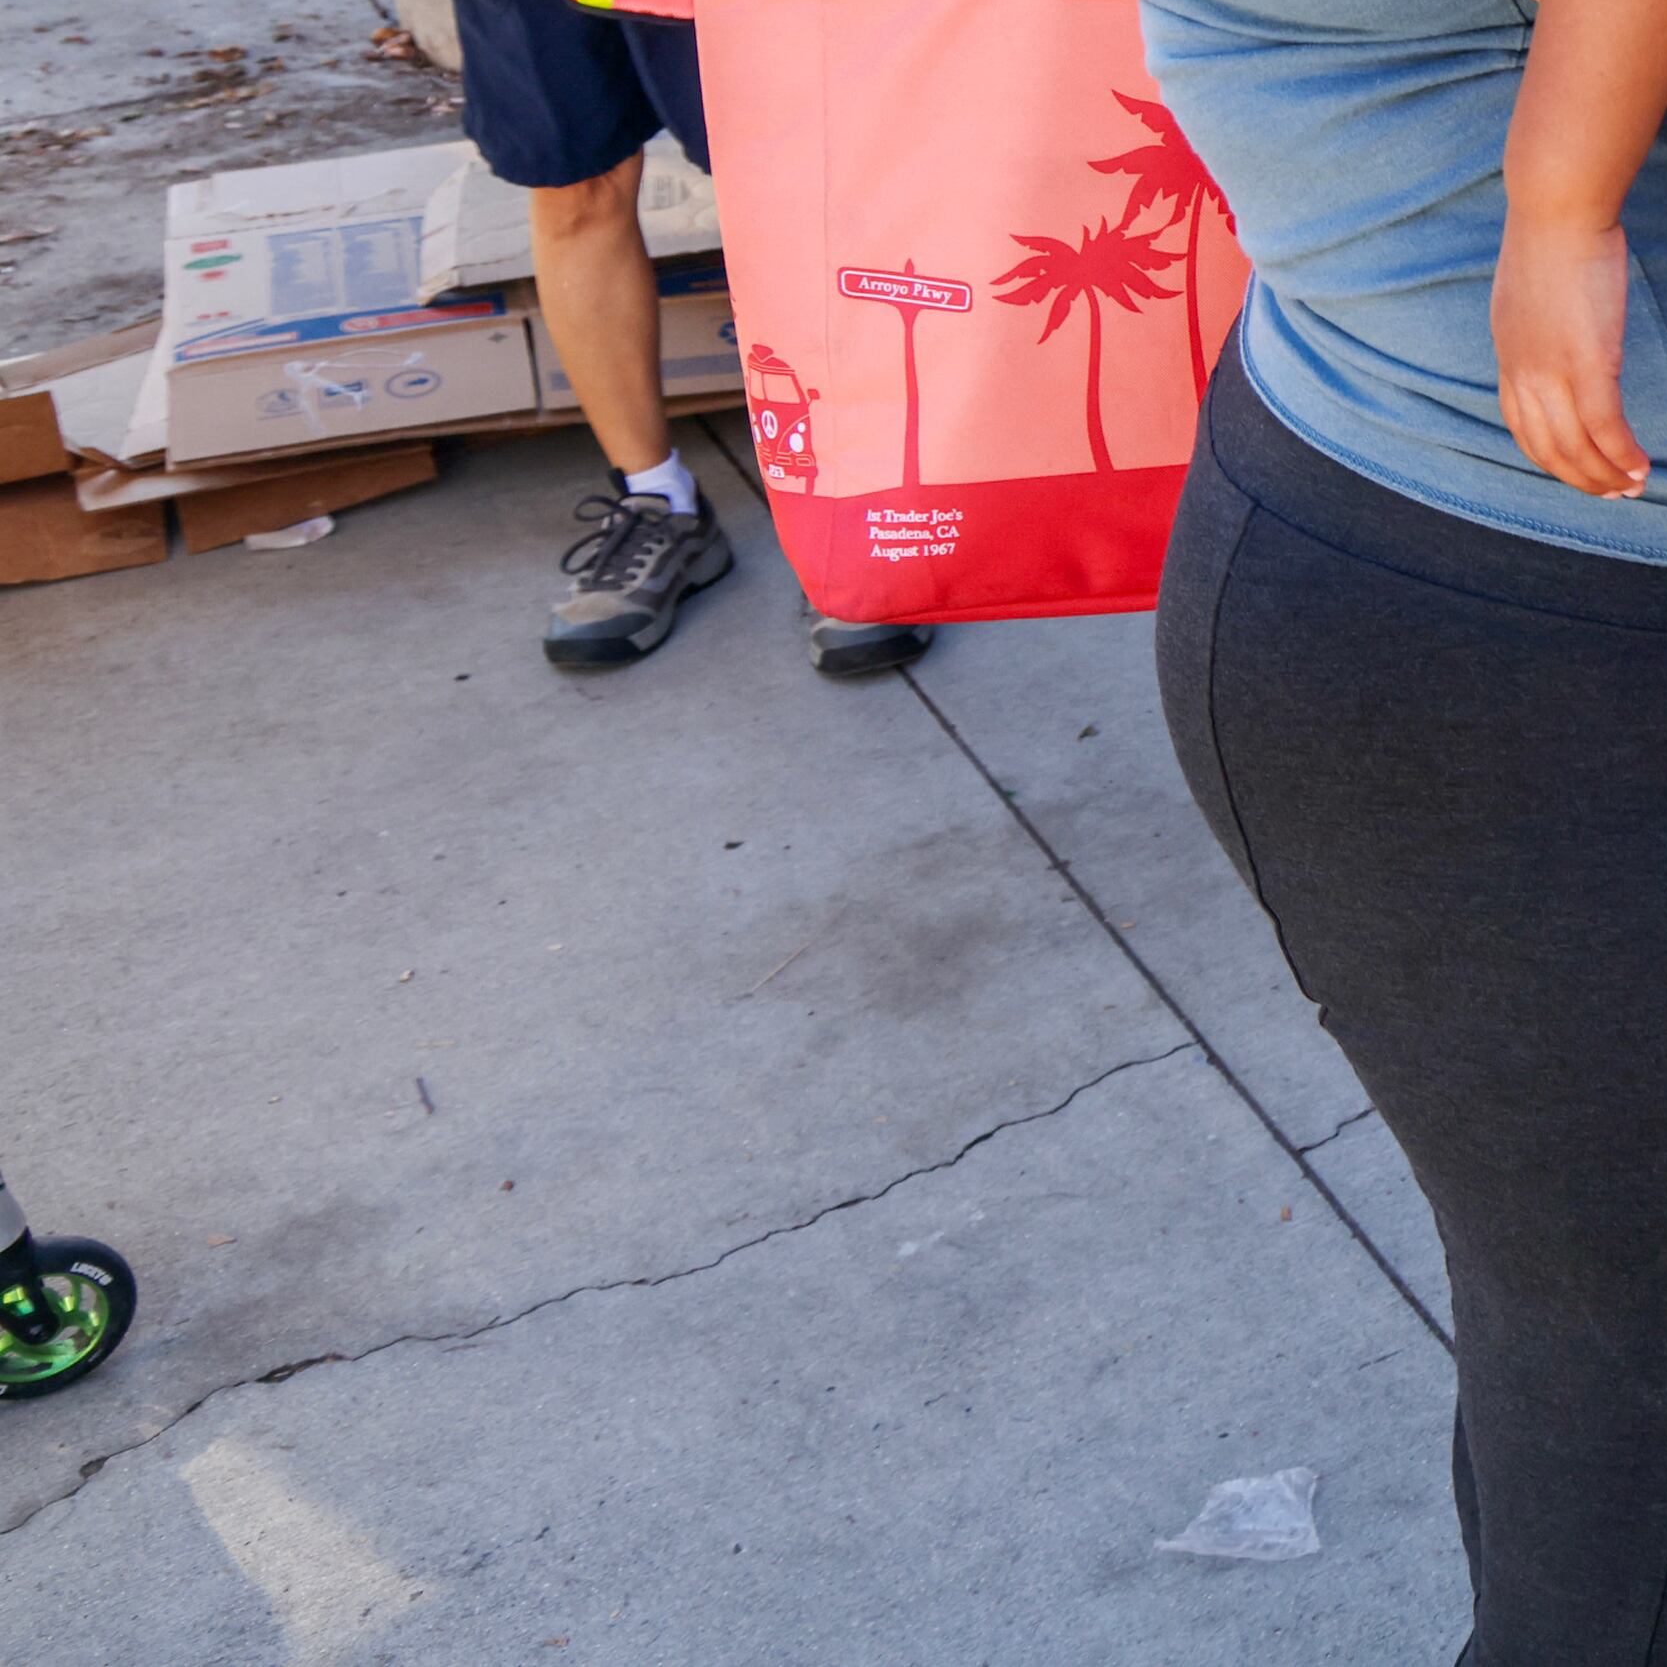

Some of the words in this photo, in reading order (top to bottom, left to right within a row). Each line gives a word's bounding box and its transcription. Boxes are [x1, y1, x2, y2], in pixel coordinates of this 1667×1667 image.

[858, 277, 909, 297] Arroyo
[912, 283, 952, 305] Pkwy
[883, 509, 929, 523] Trader
[930, 509, 963, 525] Joe's
[869, 526, 933, 541] Pasadena,
[937, 525, 960, 538] CA
[870, 544, 919, 562] August
[923, 542, 956, 556] 1967
